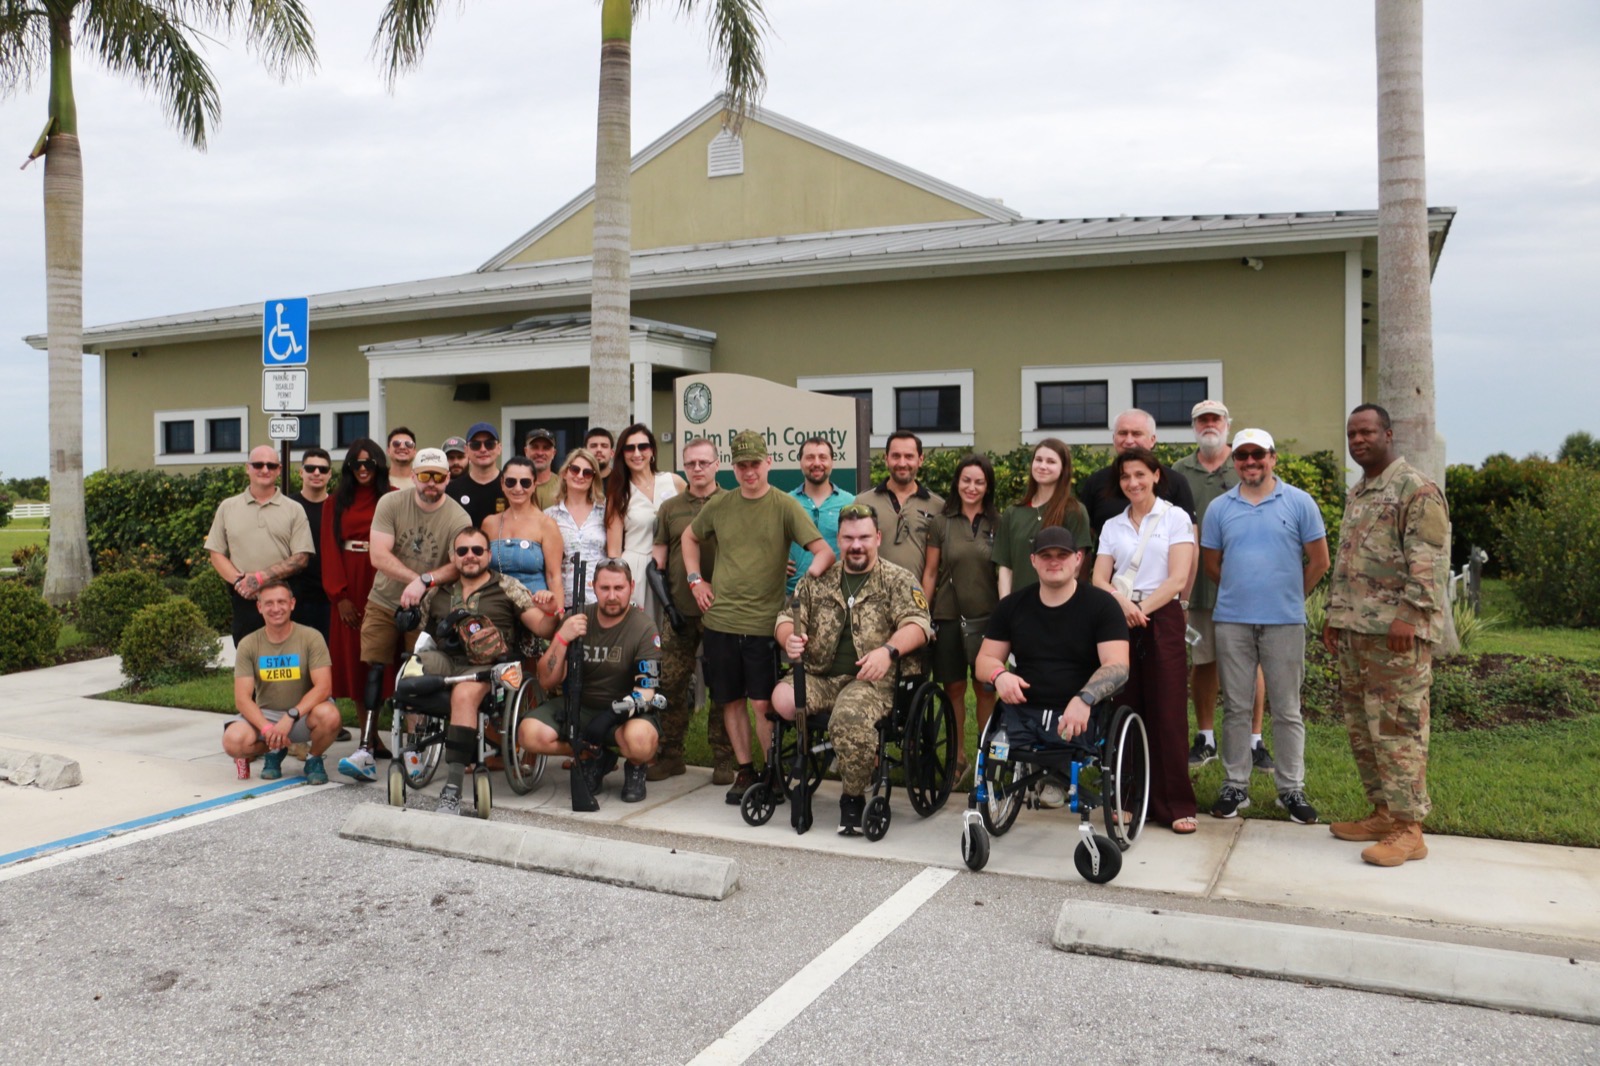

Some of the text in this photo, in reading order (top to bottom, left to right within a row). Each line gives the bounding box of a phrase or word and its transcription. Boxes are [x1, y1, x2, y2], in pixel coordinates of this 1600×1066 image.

[292, 374, 297, 382] BY
[272, 424, 296, 433] $250 FINE
[583, 645, 608, 662] 5.11
[266, 656, 291, 668] STAY
[266, 669, 292, 679] ZERO
